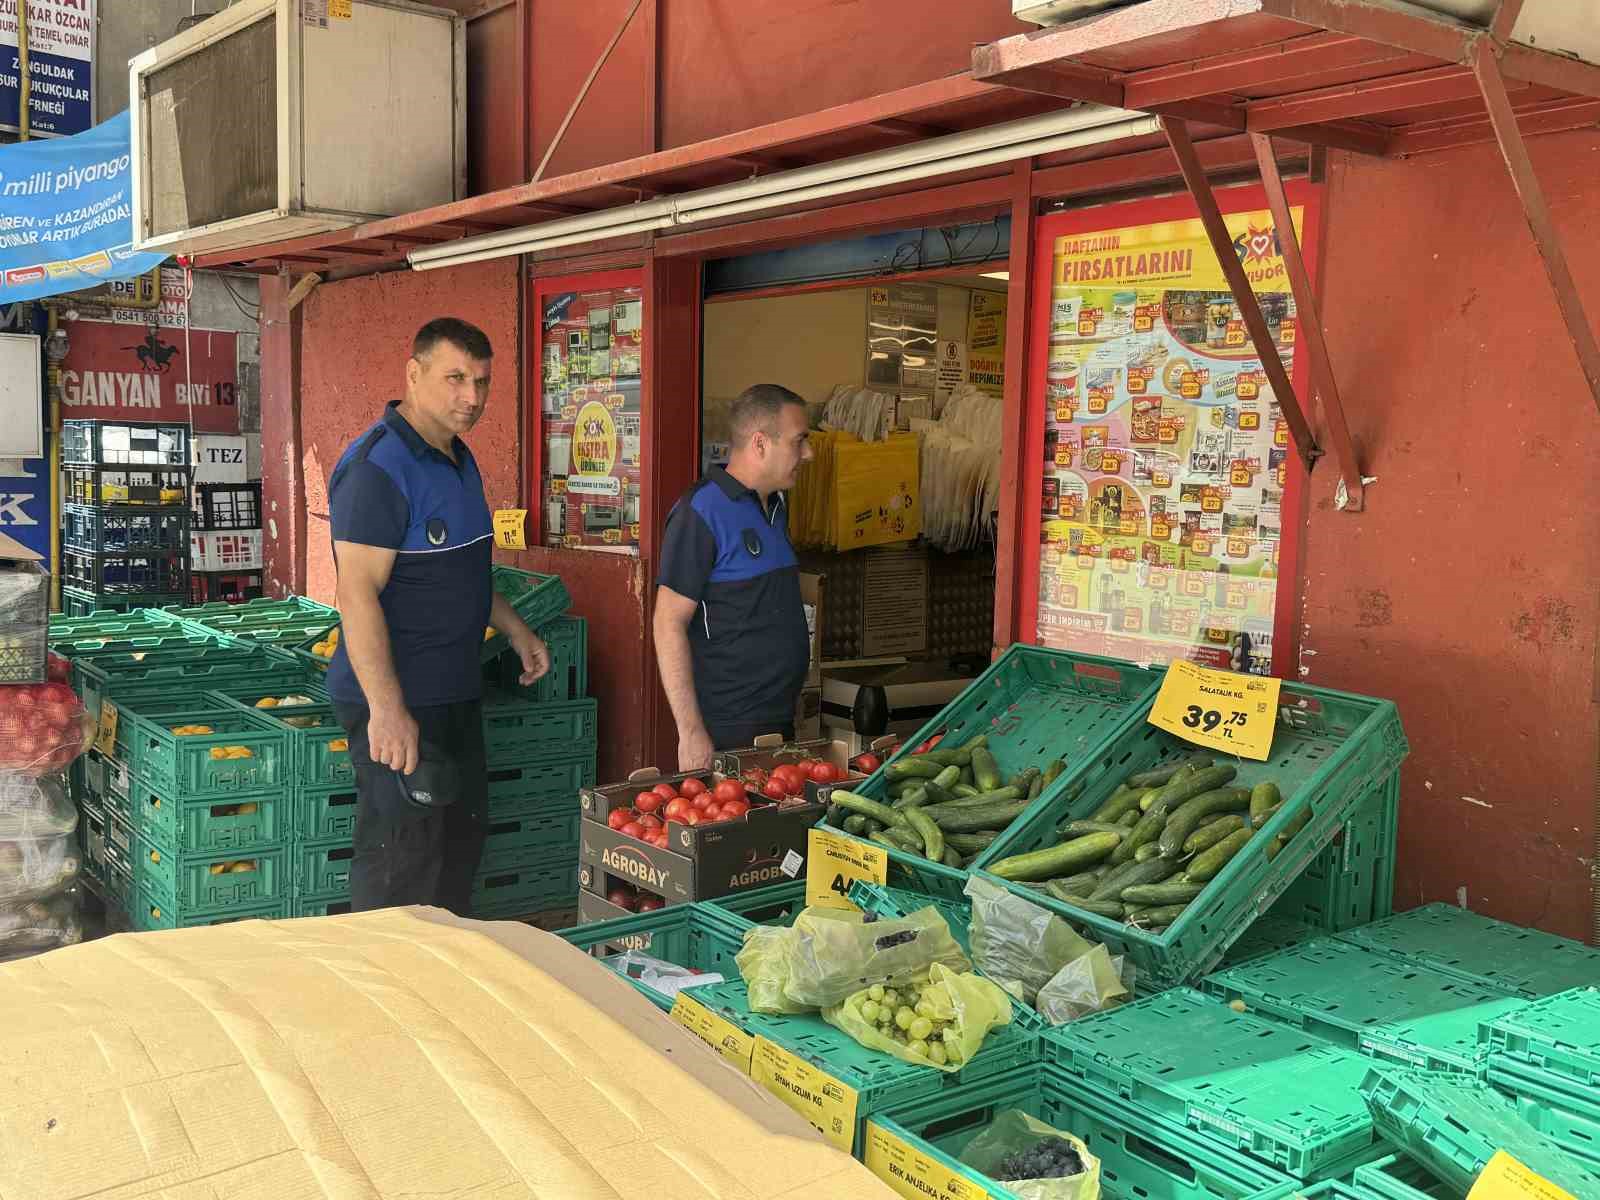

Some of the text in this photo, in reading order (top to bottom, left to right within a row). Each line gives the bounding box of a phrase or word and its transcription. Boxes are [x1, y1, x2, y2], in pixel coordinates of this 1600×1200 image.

[55, 9, 90, 32] ÖZCAN
[34, 26, 61, 43] TEMEL
[12, 57, 74, 80] ZNGULDAK
[30, 80, 89, 102] UKUKÇULAR
[3, 154, 129, 196] milli piyango
[1063, 235, 1121, 256] HAFTANIN
[1063, 248, 1193, 283] FIRSATLARINI
[161, 285, 185, 297] OTO
[61, 370, 161, 409] GANYAN
[214, 382, 236, 406] 13
[206, 448, 242, 464] TEZ
[1199, 685, 1233, 698] SALATALIK
[1223, 727, 1233, 738] TL
[602, 848, 667, 888] AGROBAY
